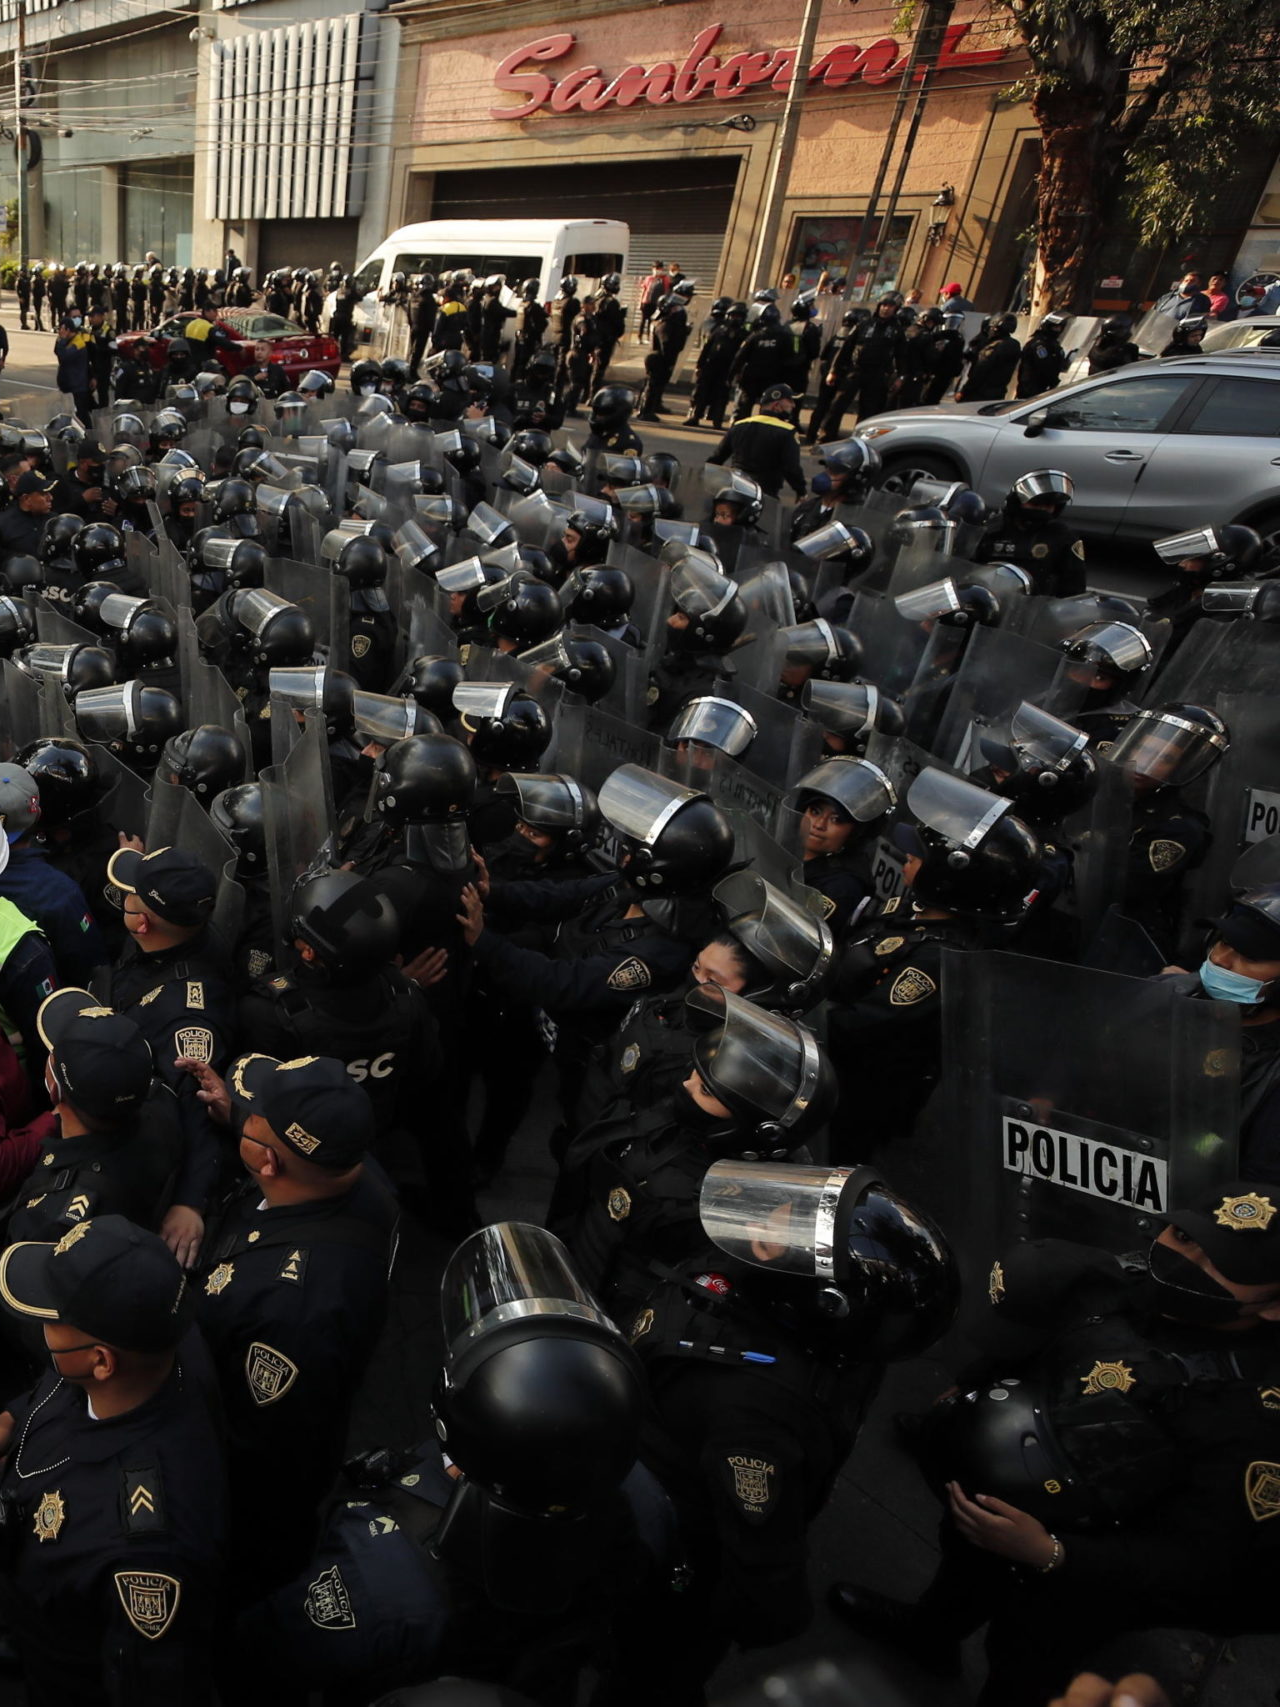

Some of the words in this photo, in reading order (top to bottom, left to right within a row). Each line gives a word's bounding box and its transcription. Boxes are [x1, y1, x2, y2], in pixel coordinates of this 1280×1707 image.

[1008, 1122, 1162, 1212] POLICIA
[254, 1347, 290, 1377] POLICIA
[727, 1456, 776, 1476] POLICIA
[121, 1575, 171, 1592] POLICIA
[331, 1570, 351, 1622] POLICIA
